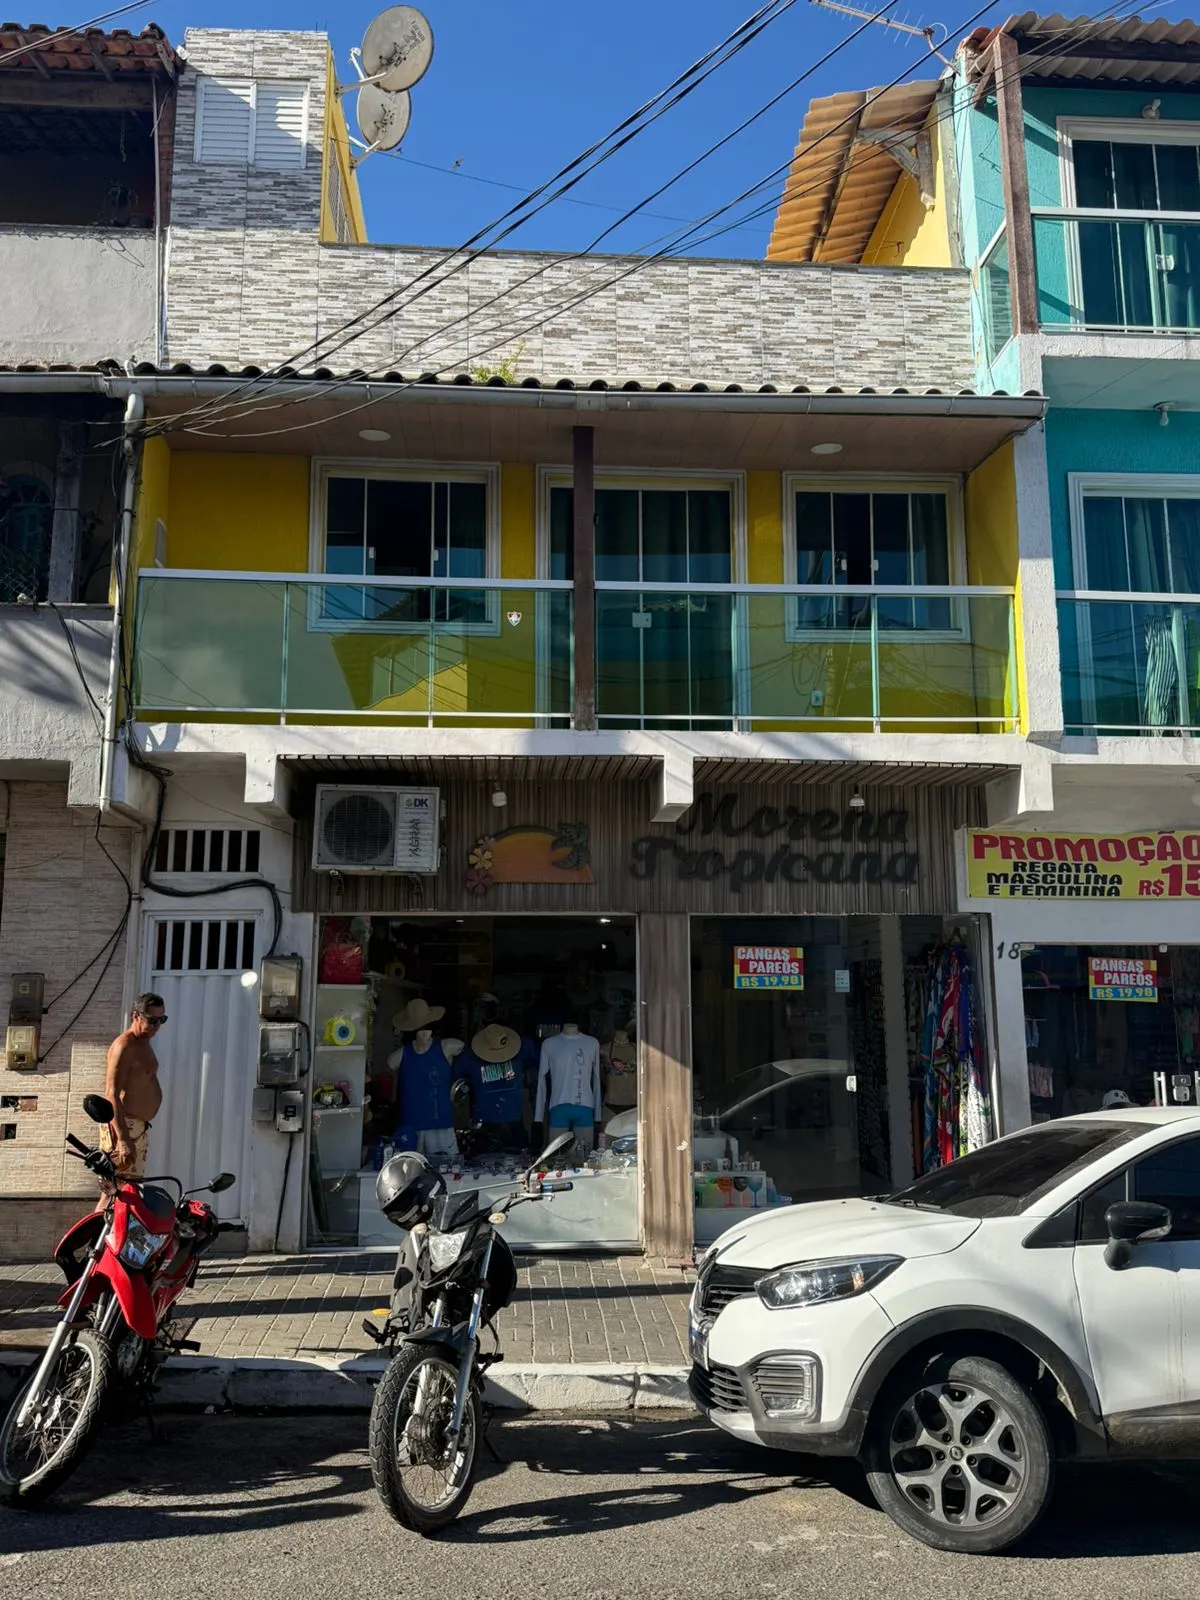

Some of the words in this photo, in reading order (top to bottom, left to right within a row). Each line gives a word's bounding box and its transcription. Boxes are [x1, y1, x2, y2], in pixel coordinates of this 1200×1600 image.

[414, 798, 429, 808] DK
[676, 792, 910, 843] Morena
[629, 836, 920, 894] Tropicana
[1012, 861, 1098, 874] REGATA
[986, 872, 1123, 886] MASCULINA
[988, 884, 1000, 896] E
[1009, 884, 1121, 897] FEMININA
[737, 947, 790, 961] CANGAS
[997, 941, 1021, 960] 18
[1091, 959, 1144, 973] CANGAS
